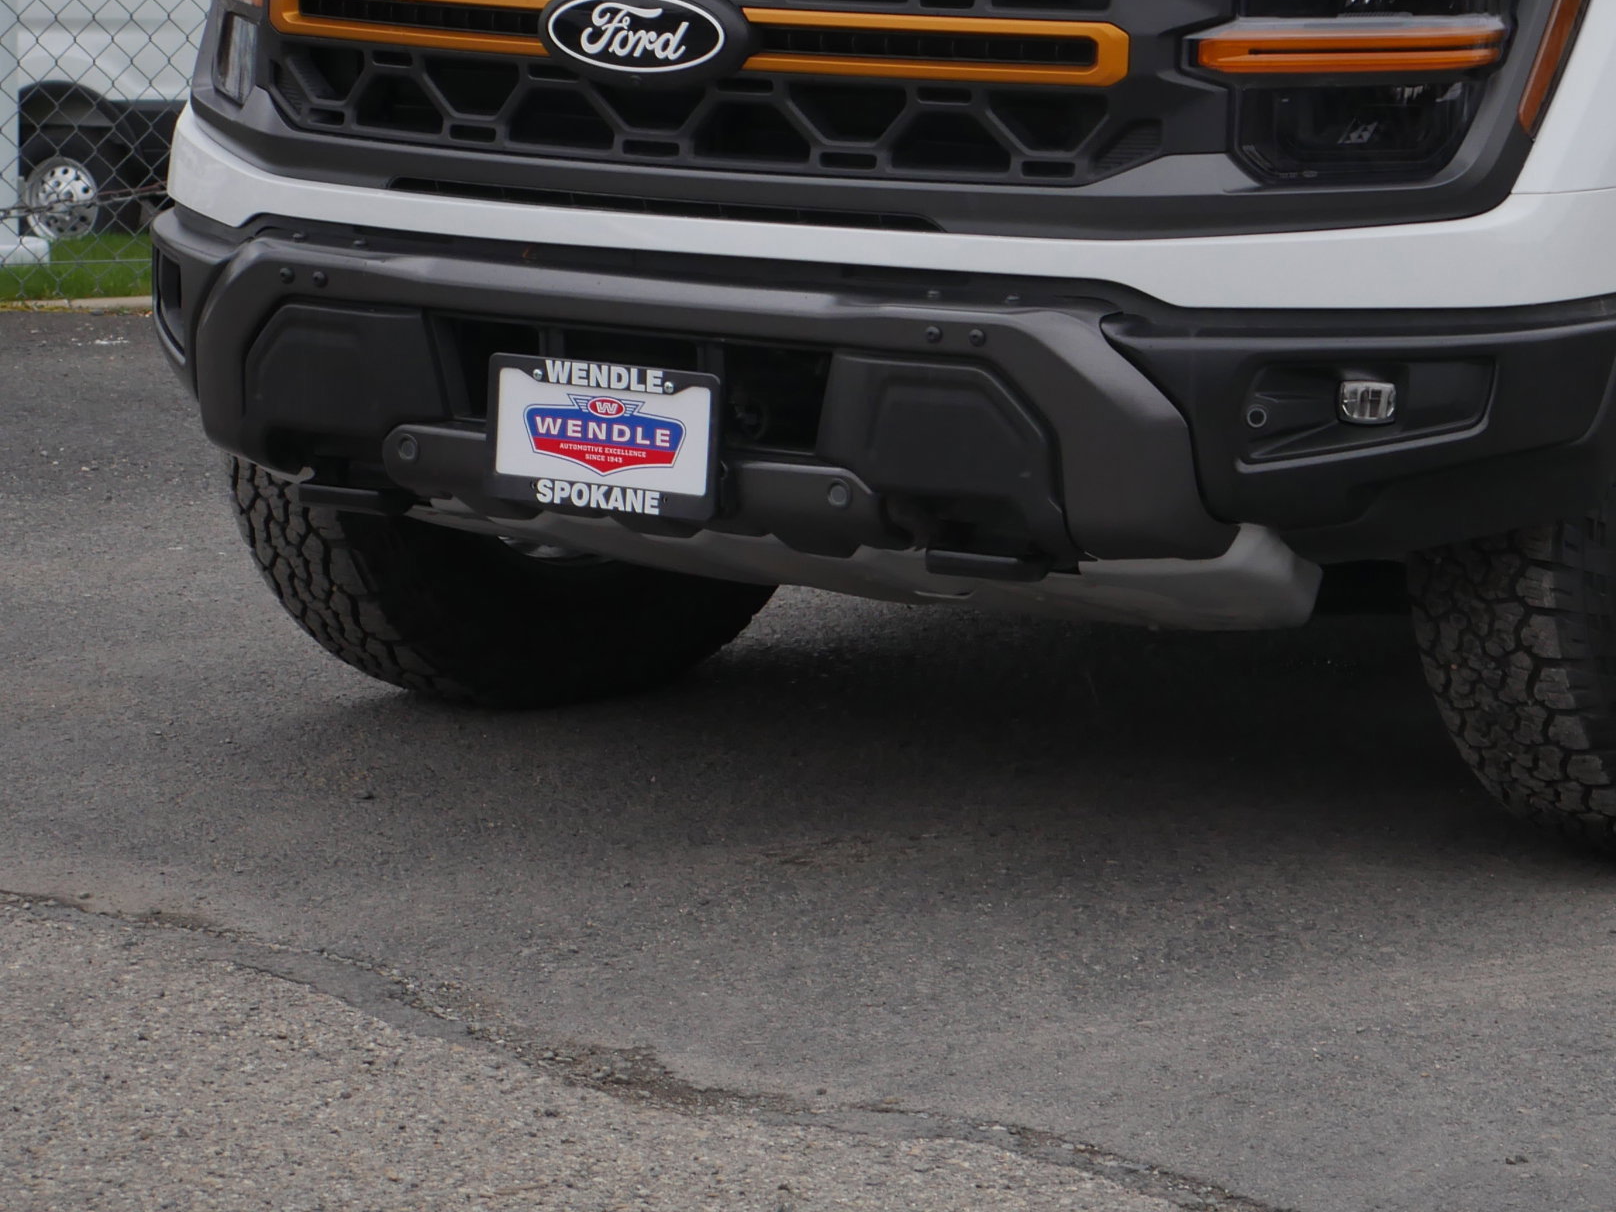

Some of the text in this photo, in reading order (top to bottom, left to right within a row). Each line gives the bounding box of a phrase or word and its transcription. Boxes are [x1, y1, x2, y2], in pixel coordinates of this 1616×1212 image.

[580, 2, 690, 60] Ford
[545, 359, 664, 394] WENDLE
[535, 416, 670, 447] WENDLE
[560, 442, 647, 458] AUTOMOTIVE EXCELLENCE
[585, 453, 623, 463] SINCE 1943
[536, 478, 660, 515] SPOKANE
